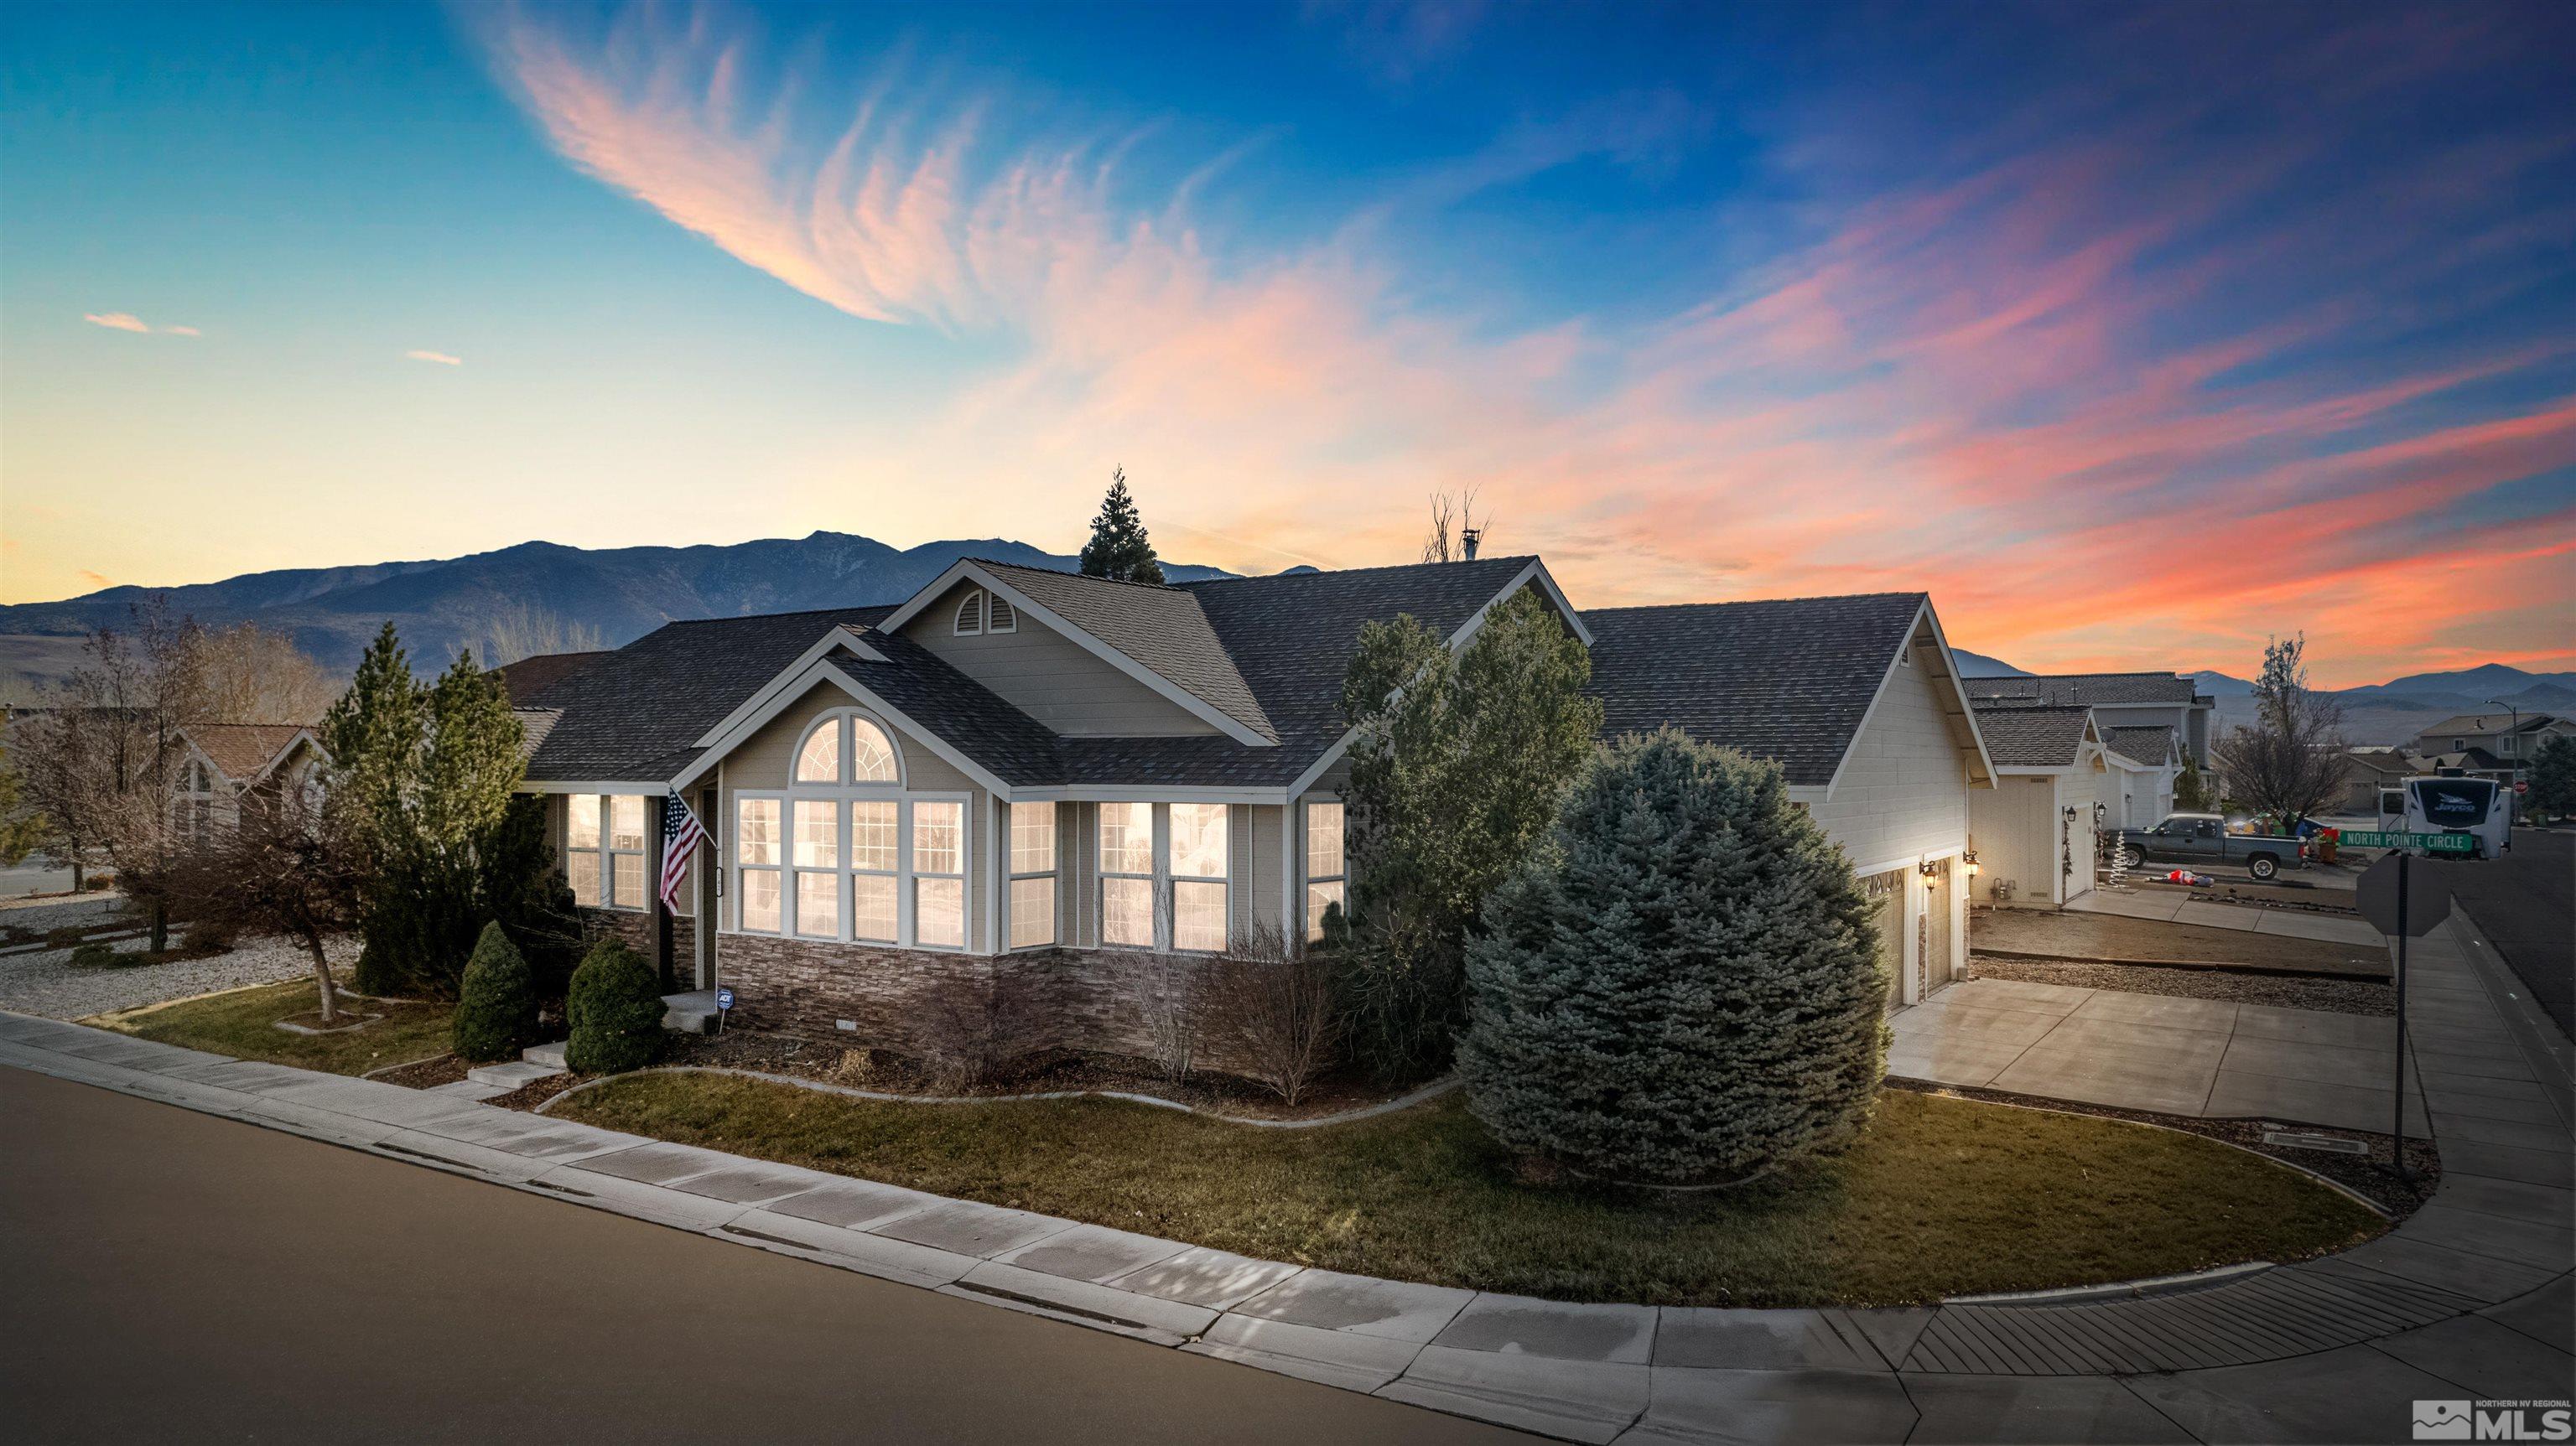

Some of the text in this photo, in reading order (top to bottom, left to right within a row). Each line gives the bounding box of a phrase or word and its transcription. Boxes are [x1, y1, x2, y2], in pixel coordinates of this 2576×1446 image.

[2434, 803, 2475, 811] Jayco
[2348, 832, 2463, 848] NORTH POINTE CIRCLE
